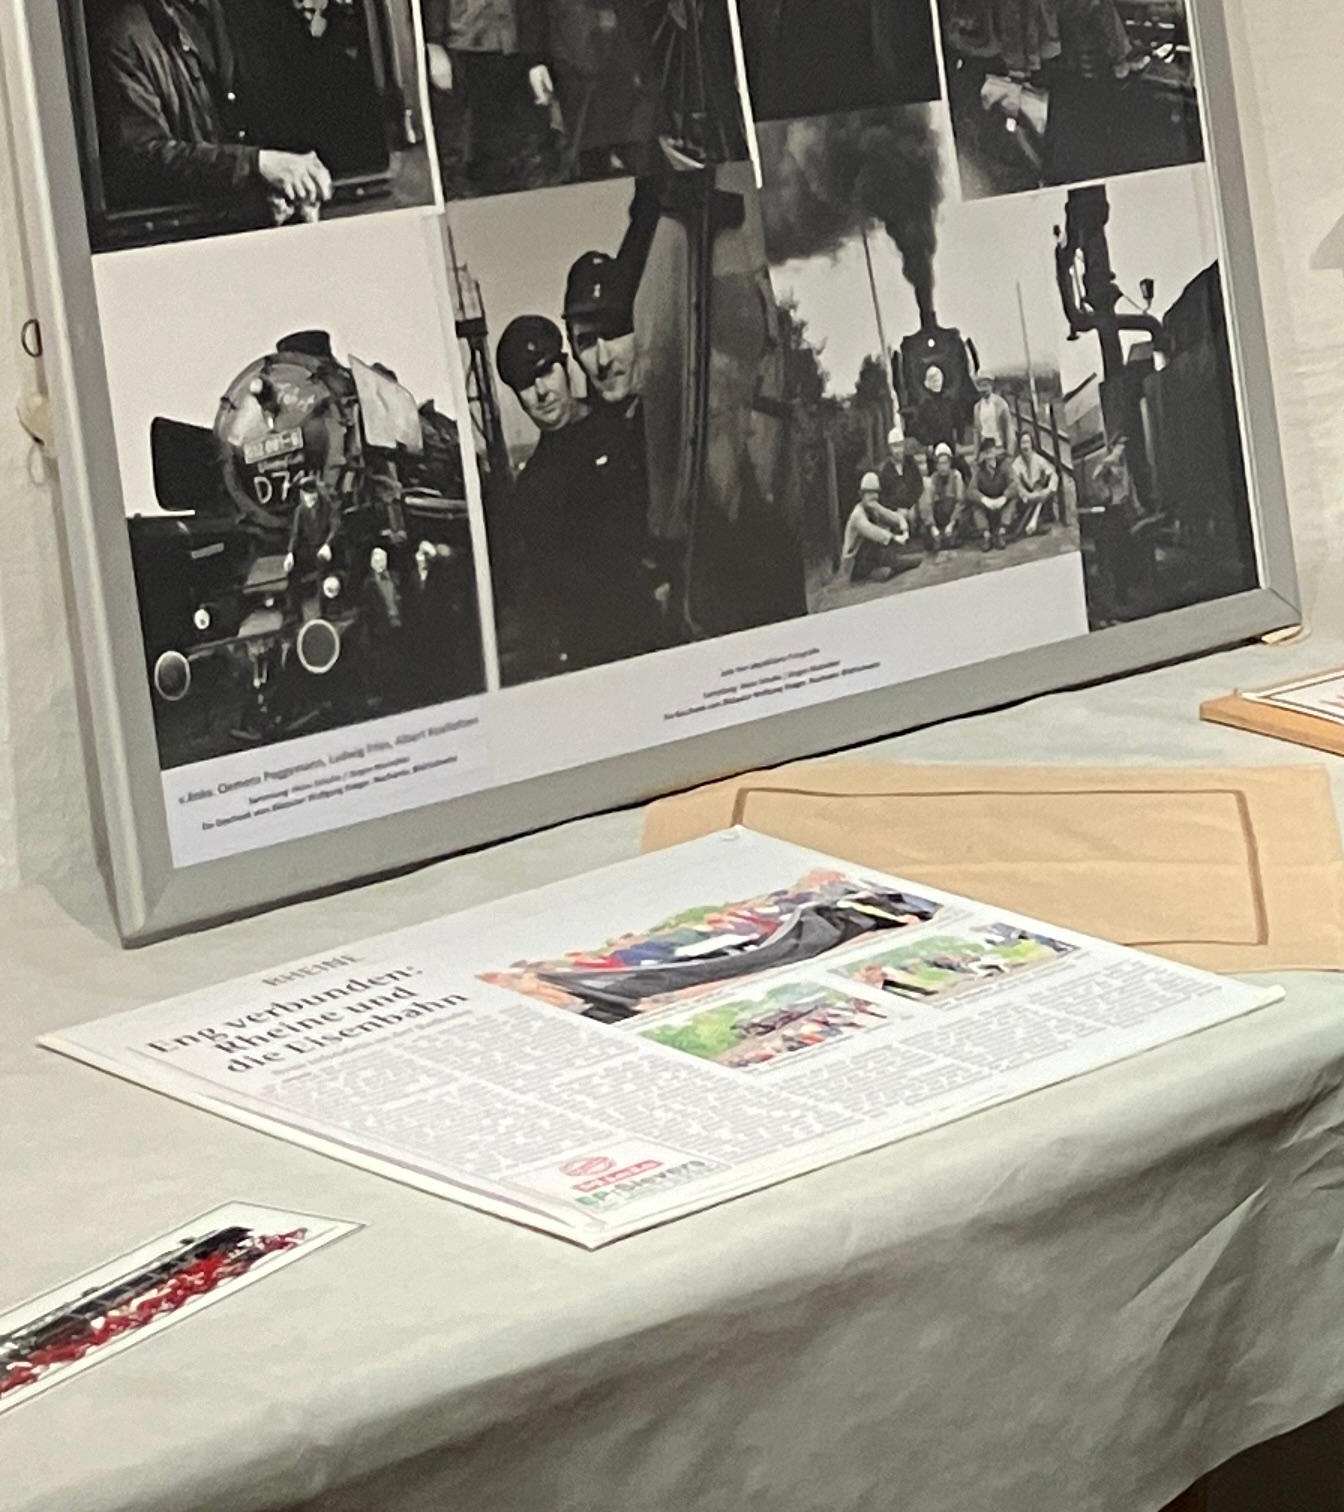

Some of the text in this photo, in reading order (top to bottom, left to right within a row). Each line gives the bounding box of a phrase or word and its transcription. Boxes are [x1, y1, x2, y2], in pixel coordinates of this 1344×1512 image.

[262, 953, 366, 987] RHEINE
[147, 965, 424, 1054] Eng verbunden:
[215, 985, 419, 1055] Rheine und
[227, 992, 469, 1074] die Eisenbahn
